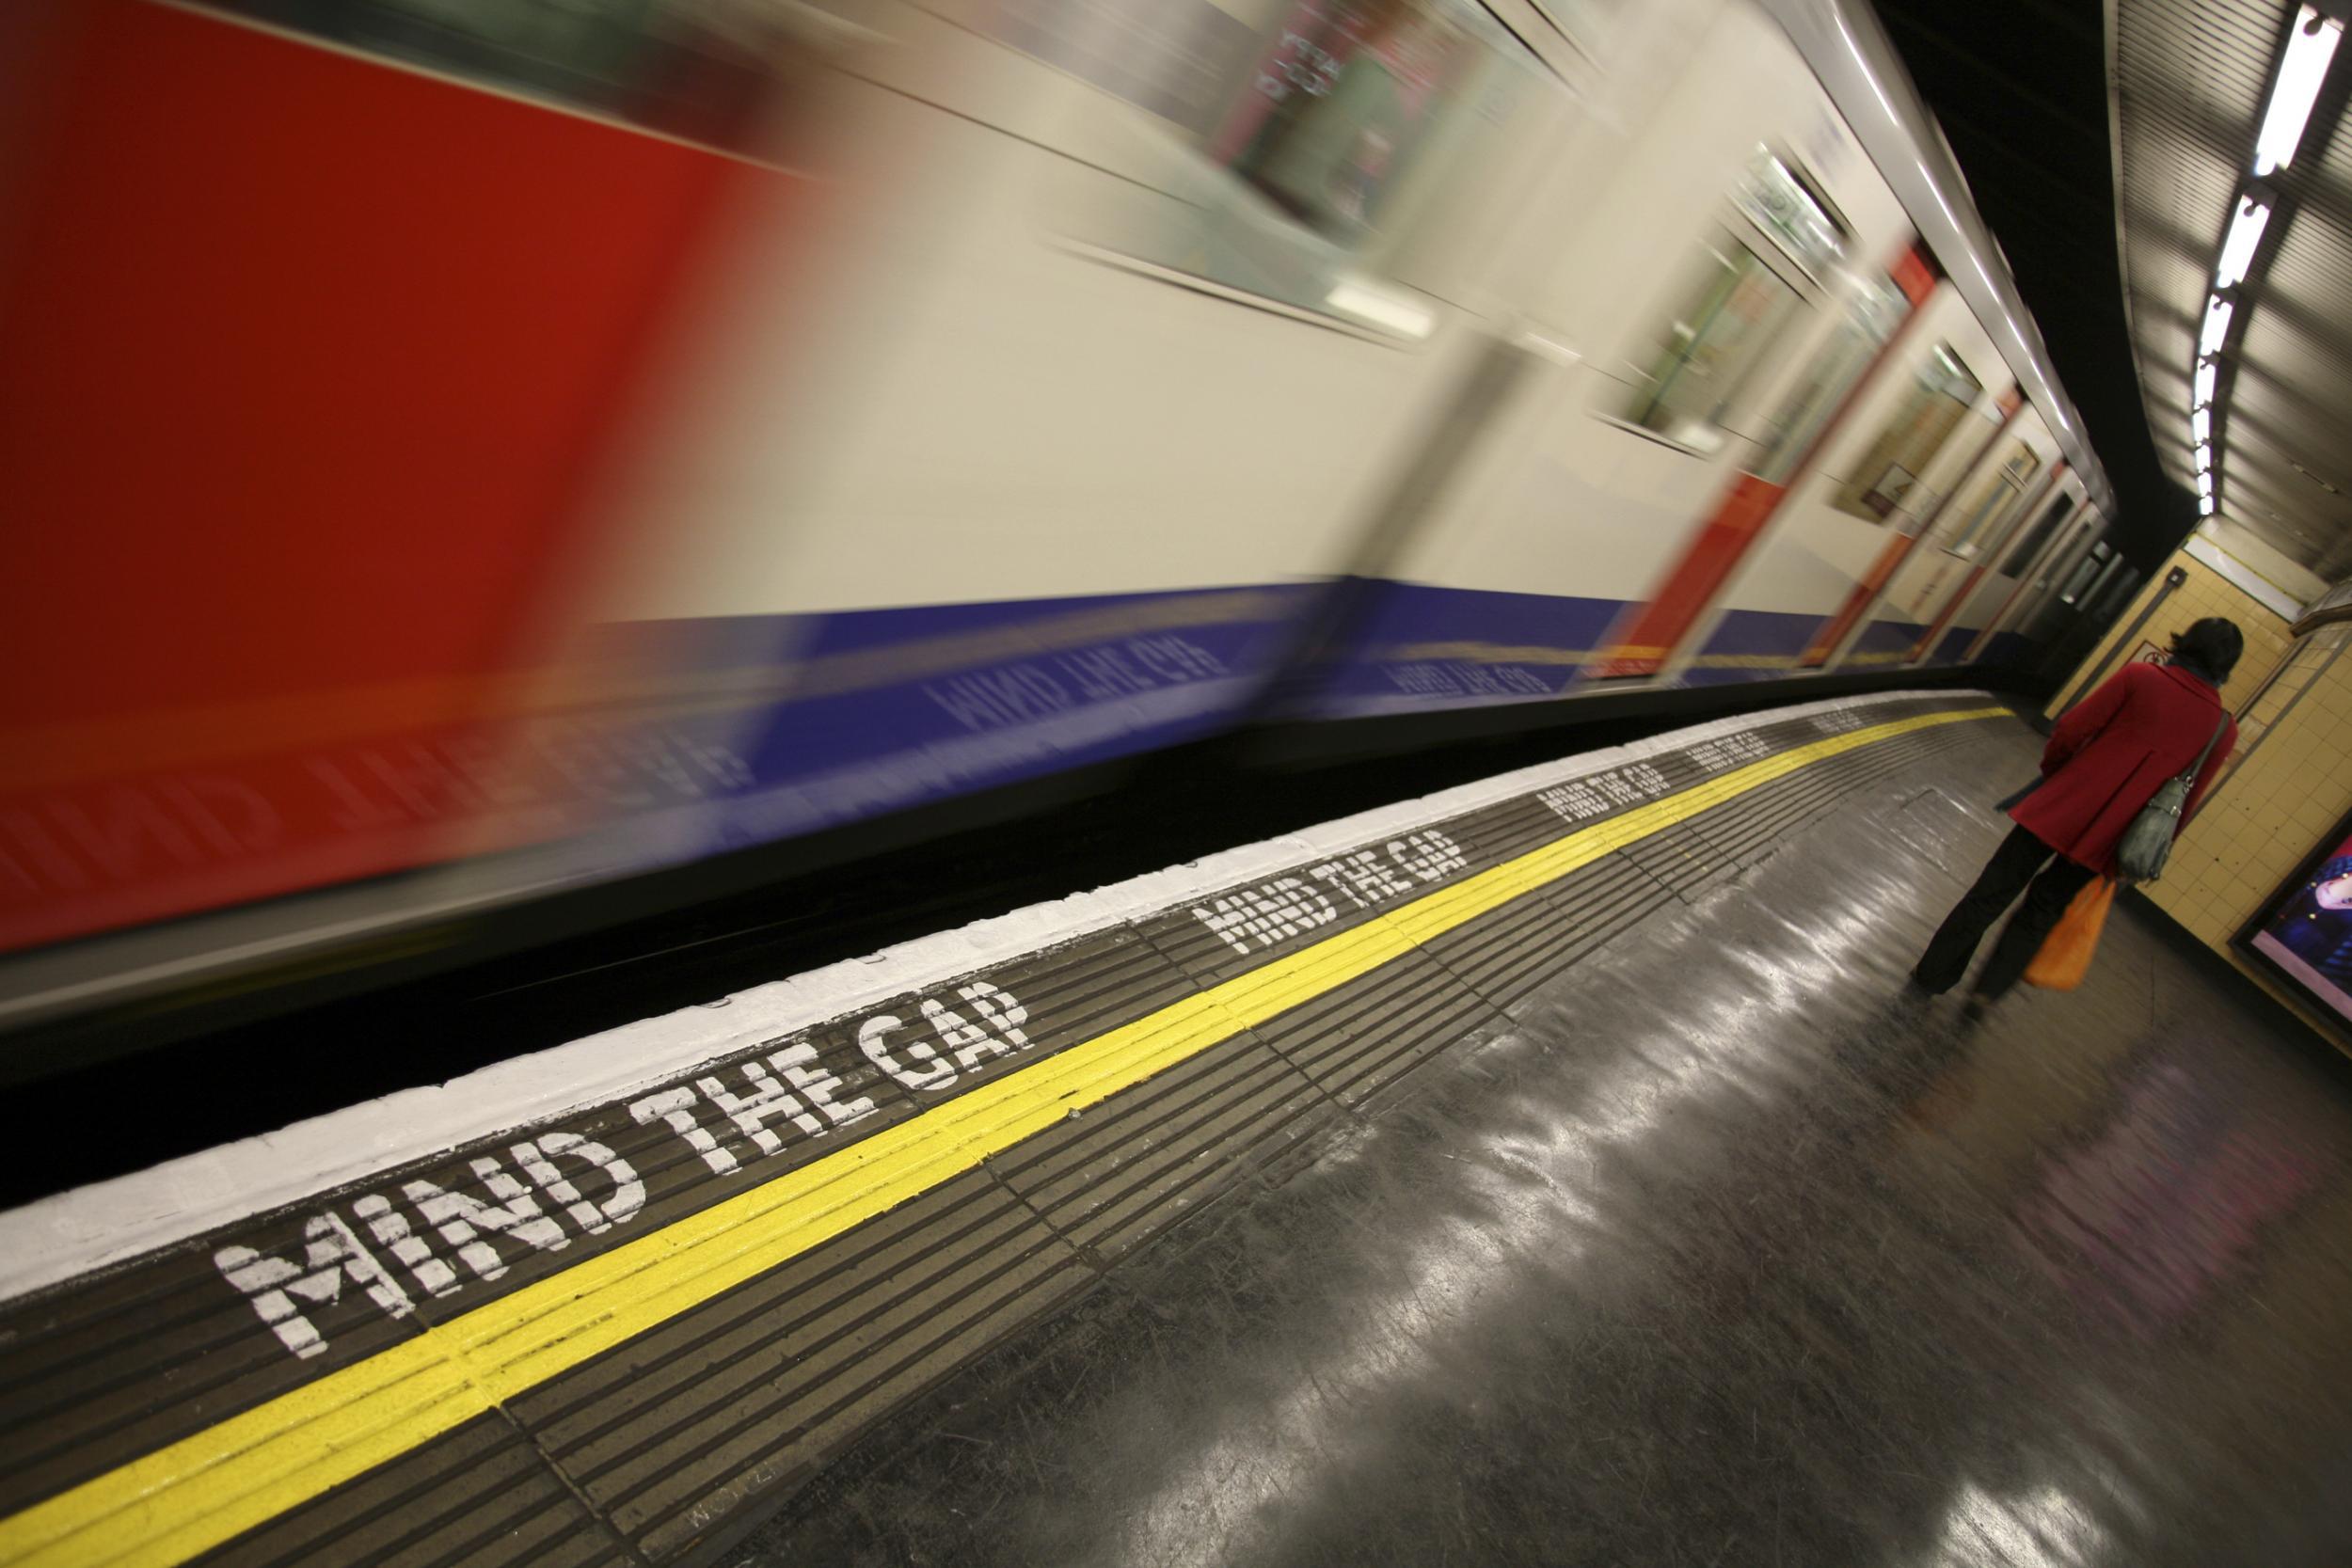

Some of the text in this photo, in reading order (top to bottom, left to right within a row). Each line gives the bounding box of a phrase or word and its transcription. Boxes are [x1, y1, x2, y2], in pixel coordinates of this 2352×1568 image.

[1191, 830, 1468, 955] MIND THE GAP
[213, 981, 1034, 1360] MIND THE GAP
